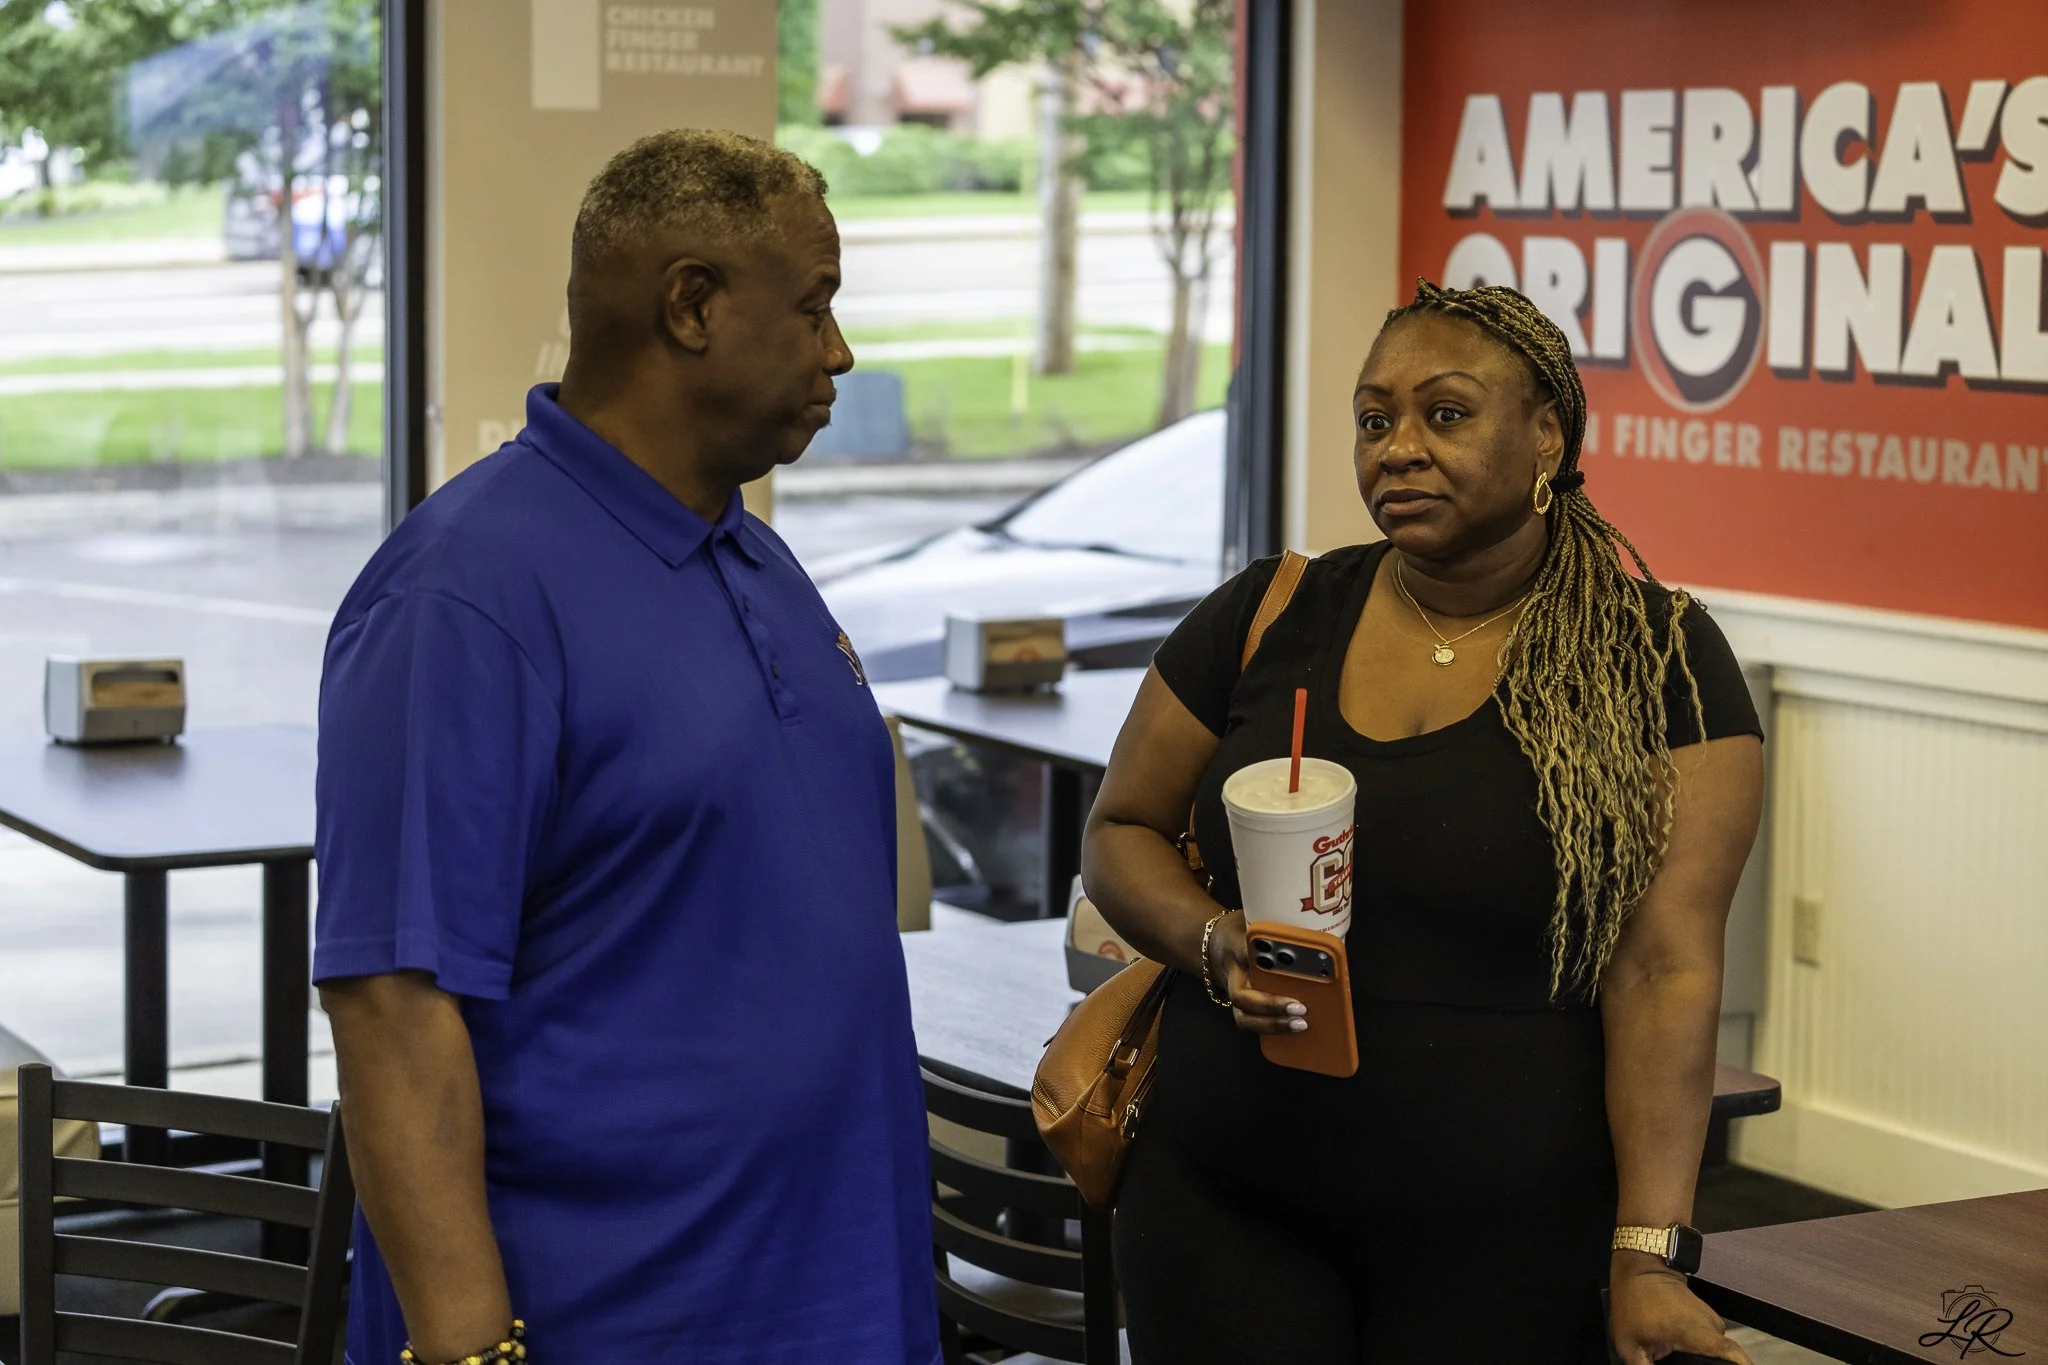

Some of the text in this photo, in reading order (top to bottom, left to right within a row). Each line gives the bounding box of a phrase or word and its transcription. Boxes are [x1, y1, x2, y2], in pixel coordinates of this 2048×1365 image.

[606, 6, 715, 28] CHICKEN
[606, 29, 700, 50] FINGER
[606, 52, 766, 76] RESTAURANT
[1443, 76, 2048, 220] AMERICA'S
[1614, 414, 1762, 468] FINGER
[1778, 425, 2048, 493] RESTAURAN
